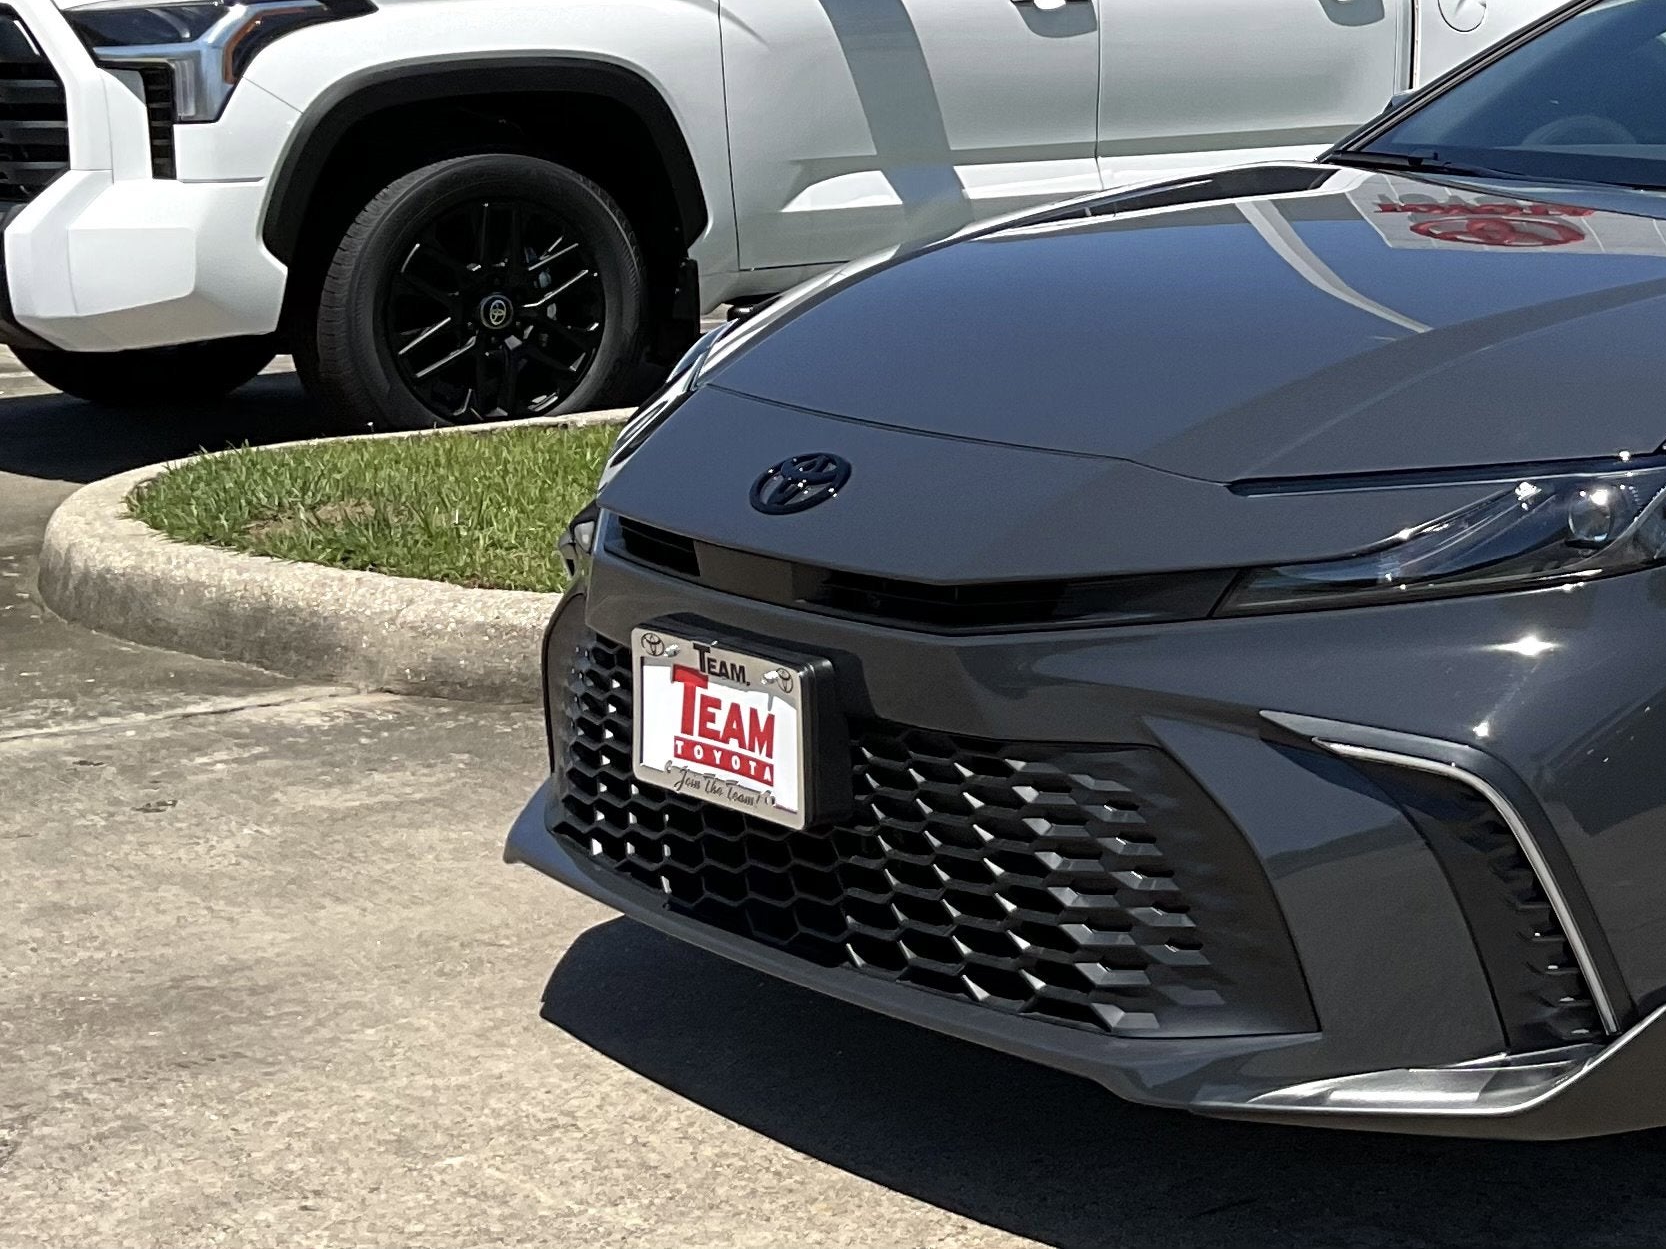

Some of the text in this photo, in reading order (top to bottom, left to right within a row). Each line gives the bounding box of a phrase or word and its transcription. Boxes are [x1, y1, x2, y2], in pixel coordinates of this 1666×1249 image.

[672, 663, 775, 759] TEAM
[674, 765, 701, 792] Join
[702, 772, 724, 796] The
[675, 739, 772, 783] TOYOTA
